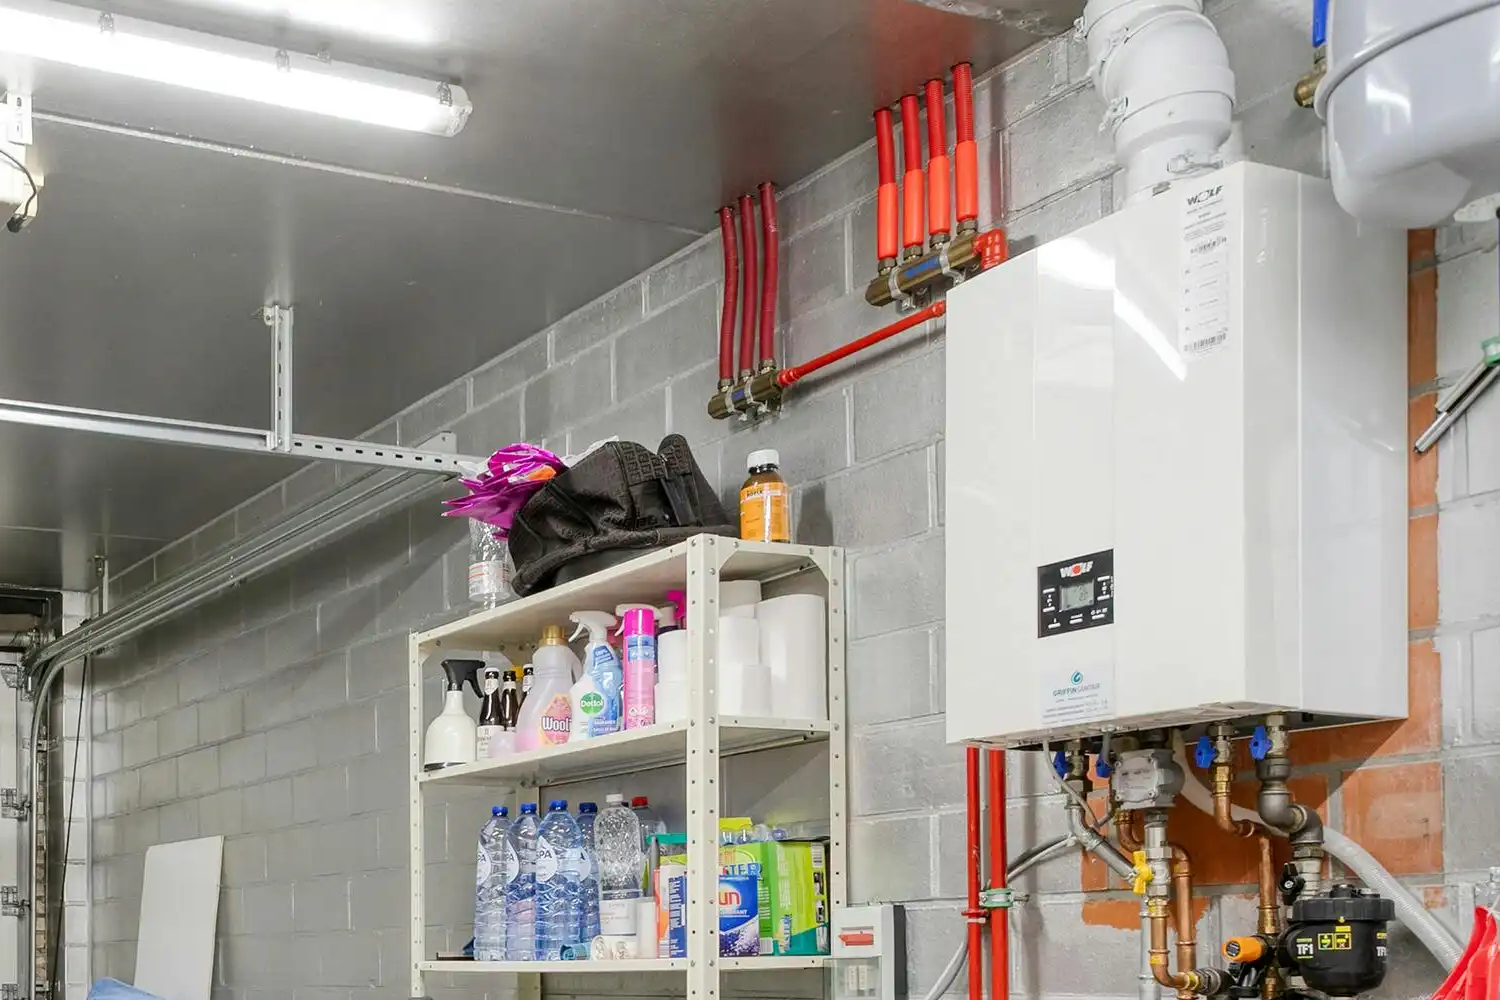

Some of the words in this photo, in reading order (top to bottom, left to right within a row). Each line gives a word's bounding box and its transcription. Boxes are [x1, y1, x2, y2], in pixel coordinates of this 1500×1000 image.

[1187, 185, 1223, 206] WOLF
[1060, 560, 1094, 578] WOLF
[719, 891, 741, 906] un
[1297, 944, 1313, 955] TF1
